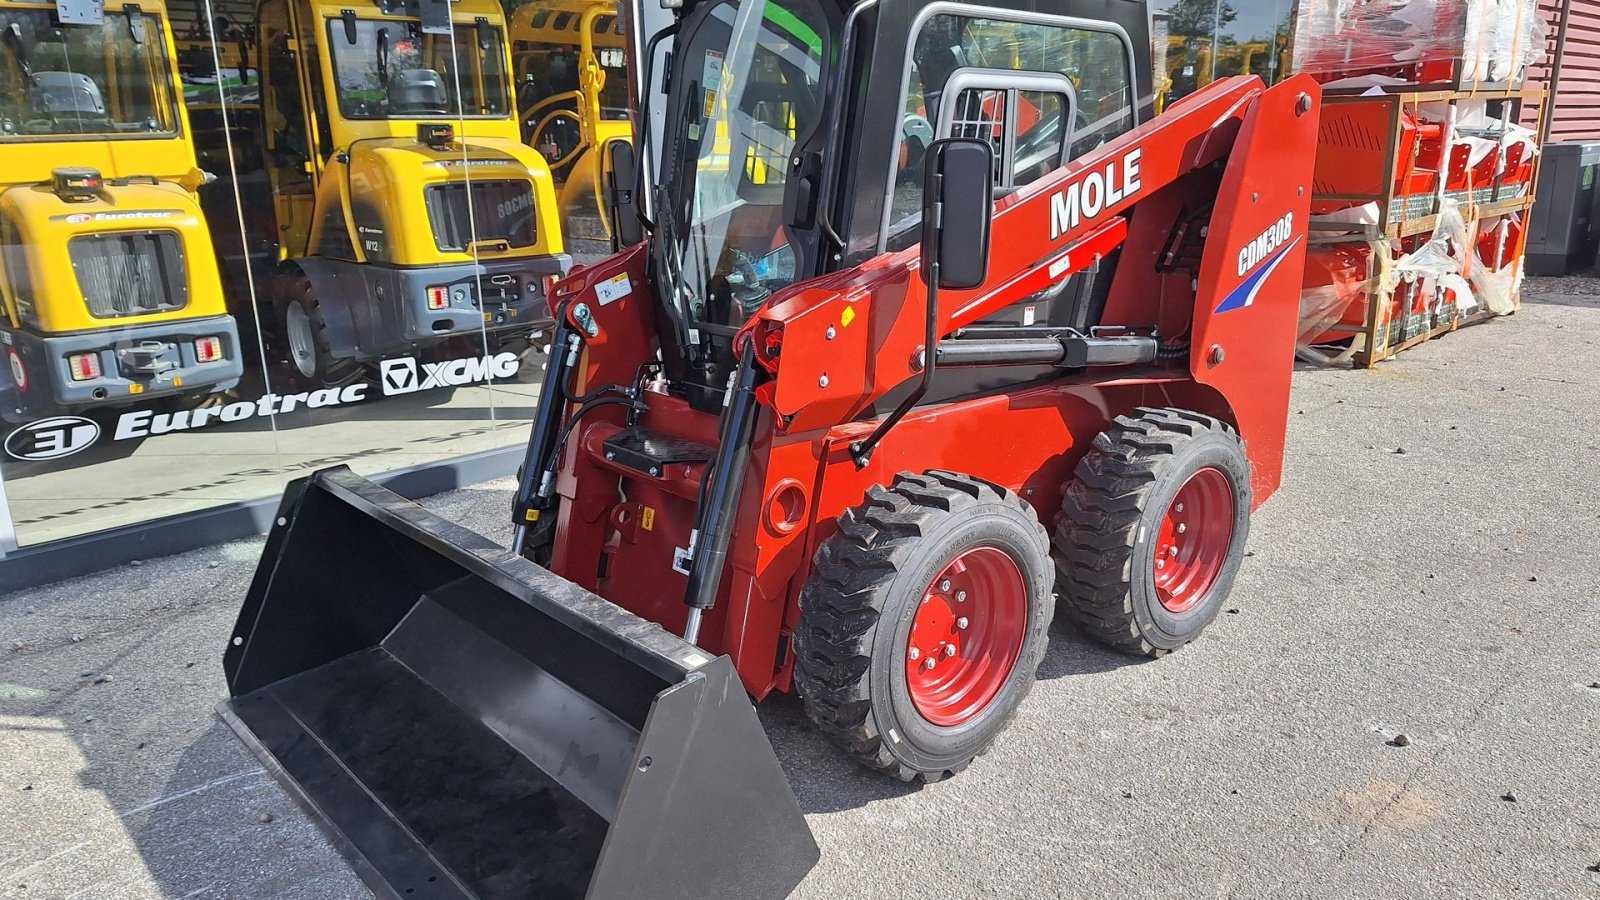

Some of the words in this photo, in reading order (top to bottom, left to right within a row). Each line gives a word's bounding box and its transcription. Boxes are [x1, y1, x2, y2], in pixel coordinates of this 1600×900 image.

[95, 211, 172, 221] Eurotrac
[1050, 146, 1141, 240] MOLE
[1237, 210, 1293, 277] CDM308
[418, 352, 519, 390] XCMG
[114, 383, 368, 441] Eurotrac
